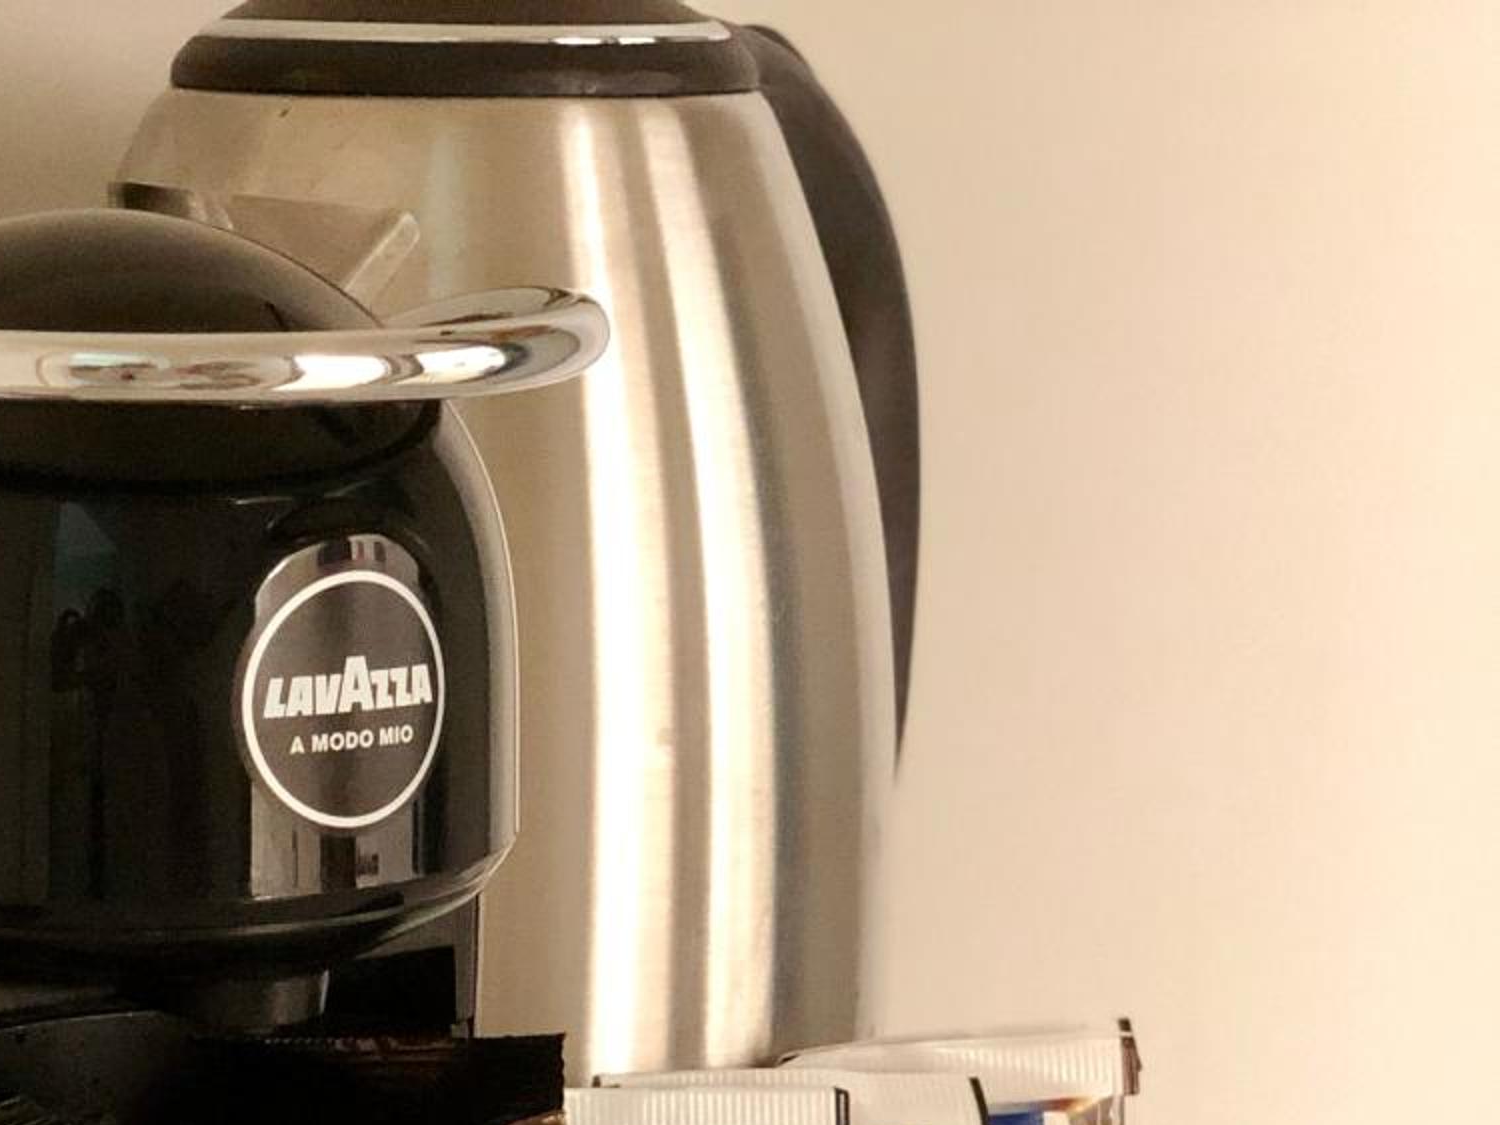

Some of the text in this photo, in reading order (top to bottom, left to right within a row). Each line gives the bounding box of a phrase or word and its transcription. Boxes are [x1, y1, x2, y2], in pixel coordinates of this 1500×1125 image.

[263, 655, 433, 719] LAVAZZA
[289, 724, 413, 755] A MODO MIO
